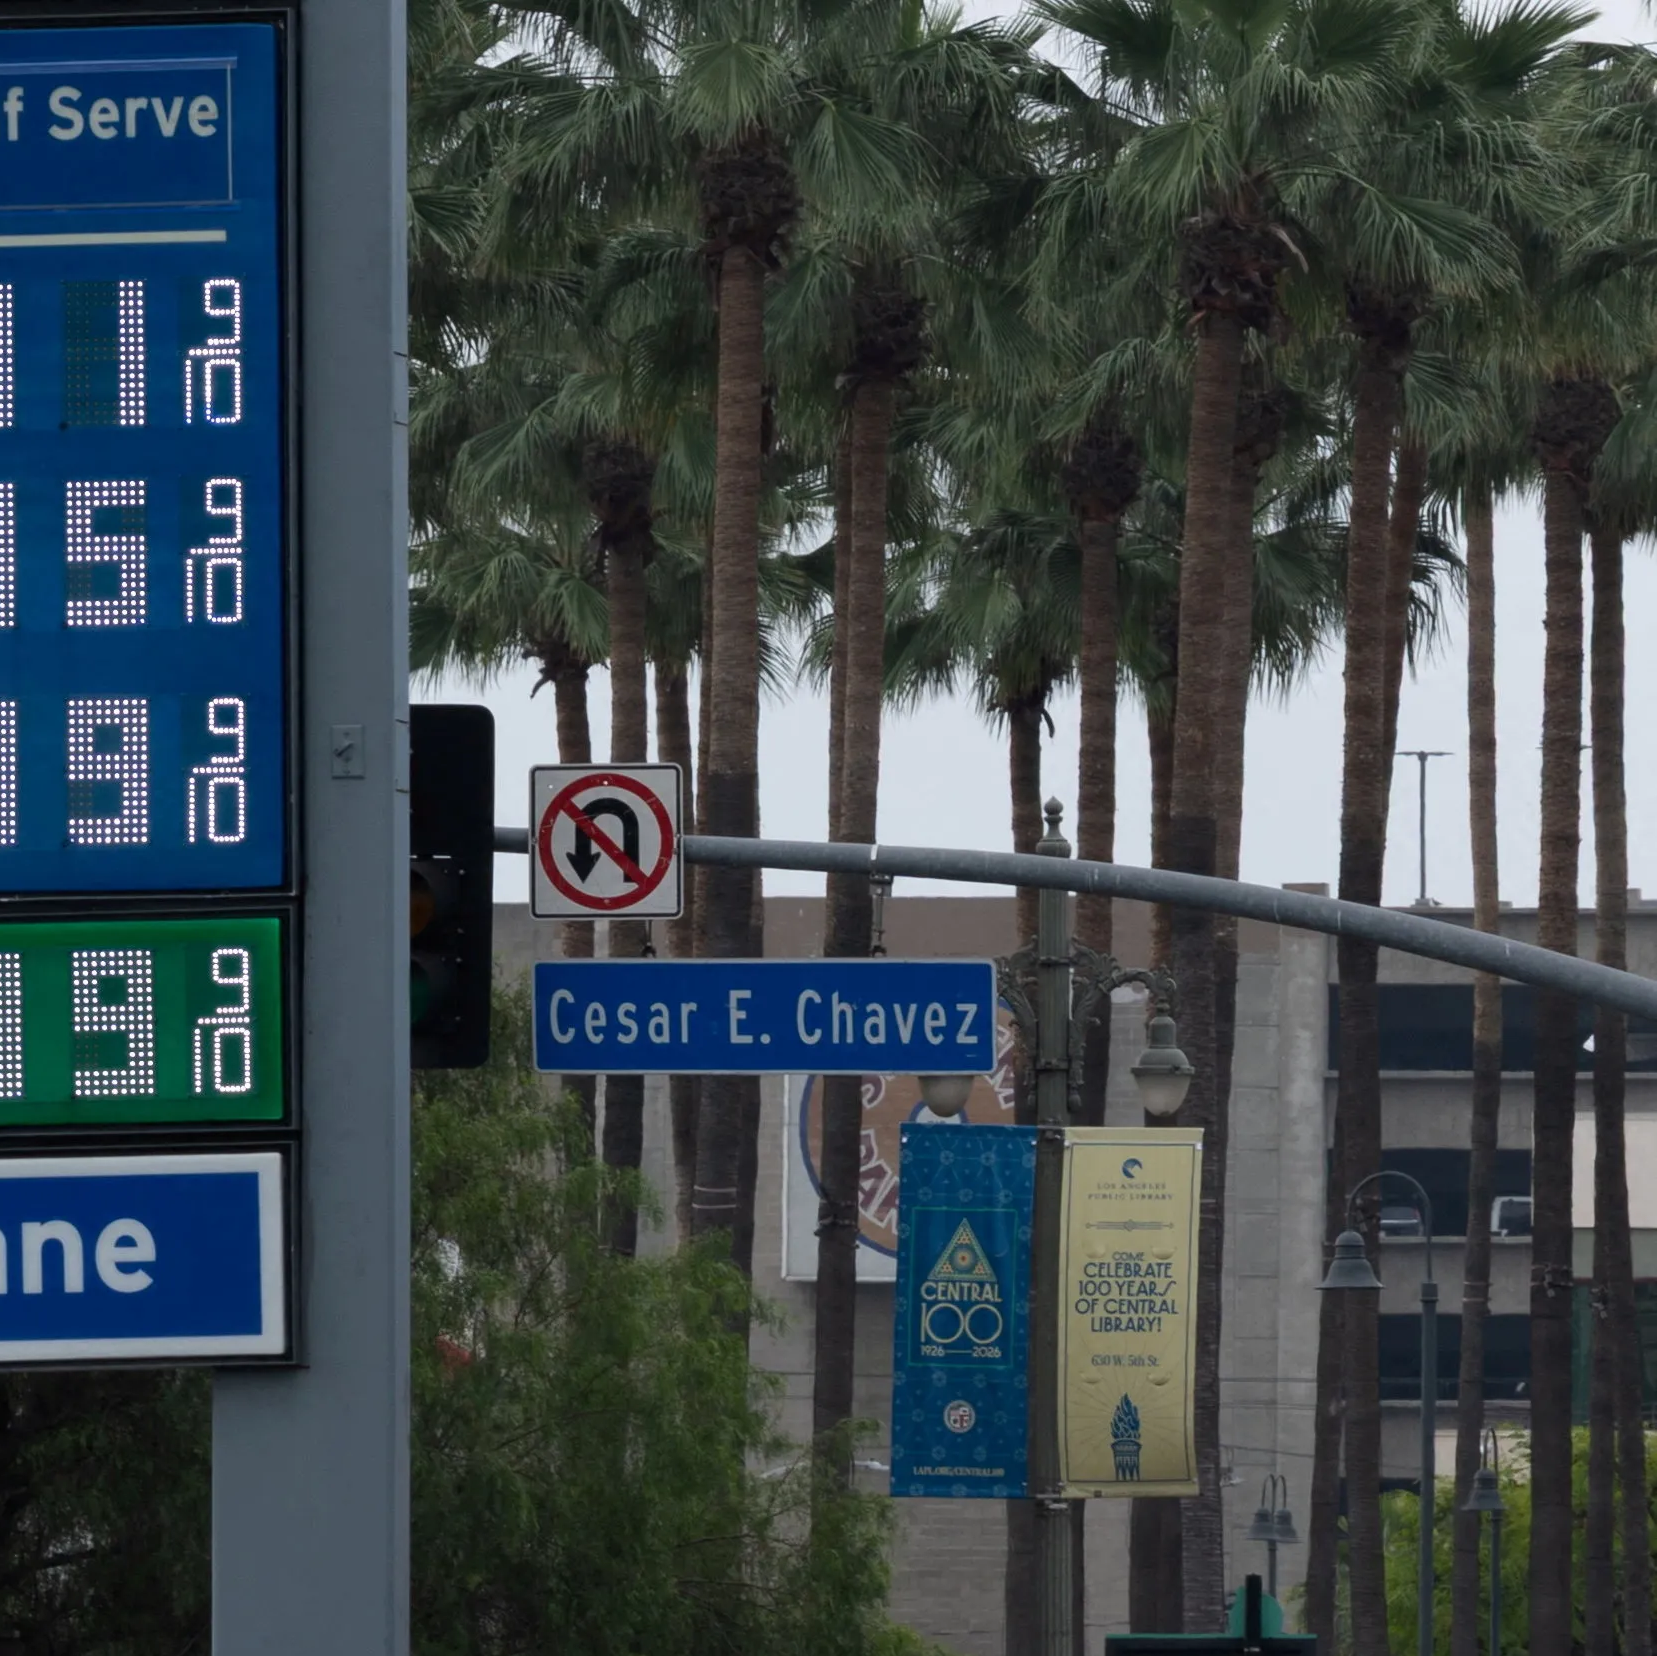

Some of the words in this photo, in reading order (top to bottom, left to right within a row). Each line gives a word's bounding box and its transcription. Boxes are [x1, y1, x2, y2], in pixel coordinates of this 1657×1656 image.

[47, 86, 220, 142] Serve
[548, 989, 693, 1046] Cesar
[727, 989, 771, 1045] E.
[796, 989, 979, 1046] Chavez
[1097, 1182, 1118, 1190] LOS
[1130, 1192, 1174, 1201] LIBRARY
[1112, 1251, 1145, 1262] COME
[1083, 1262, 1173, 1279] CELEBRATE
[920, 1281, 1003, 1303] CENTRAL
[1078, 1280, 1112, 1296] 100
[1115, 1279, 1178, 1296] YEARS
[1075, 1299, 1098, 1315] OF
[1103, 1299, 1179, 1315] CENTRAL
[920, 1303, 1004, 1345] 100
[1090, 1317, 1162, 1333] LIBRARY!
[1091, 1354, 1111, 1367] 630
